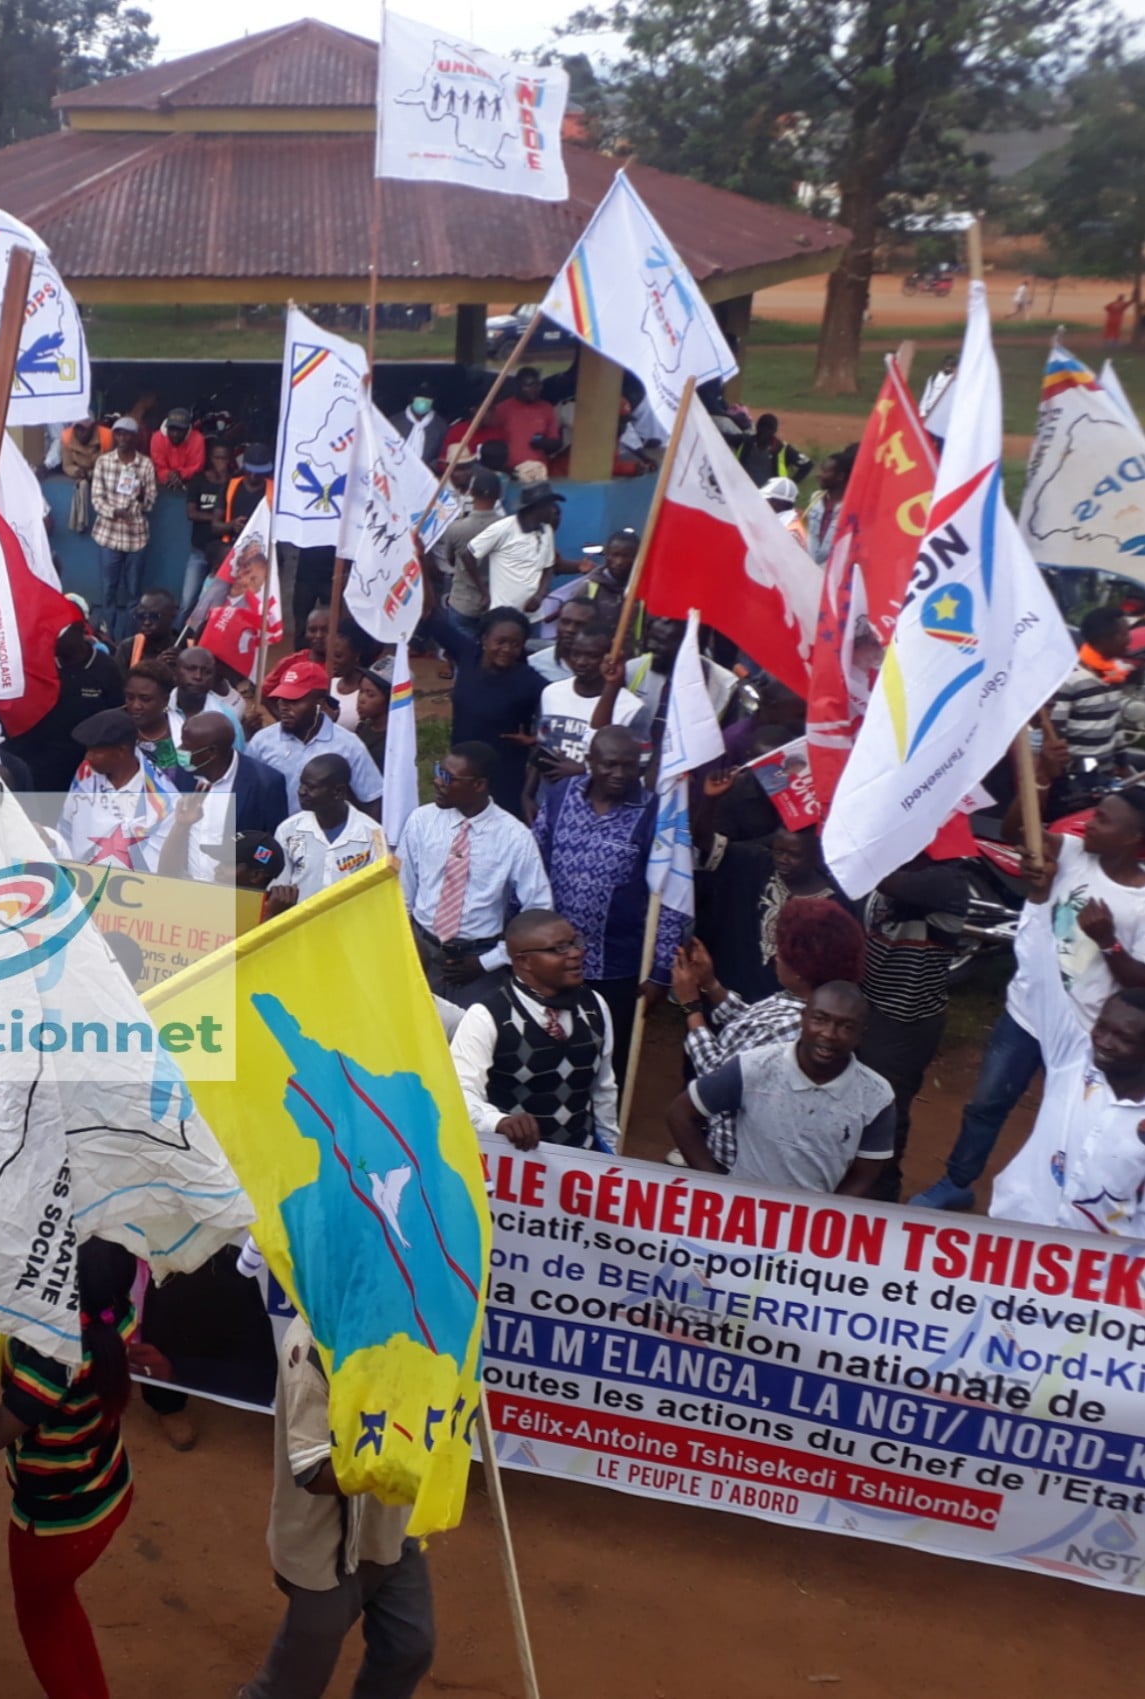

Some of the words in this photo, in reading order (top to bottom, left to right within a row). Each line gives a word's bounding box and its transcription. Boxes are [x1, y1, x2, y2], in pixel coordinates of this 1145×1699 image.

[22, 282, 57, 322] DPS
[92, 911, 183, 947] QUE/VILLE
[187, 927, 211, 953] DE
[15, 1203, 63, 1292] SOCIAL
[40, 1214, 80, 1306] RATIE
[558, 1167, 888, 1266] GÉNÉRATION
[901, 1220, 1145, 1312] TSHISEK
[489, 1248, 529, 1274] on
[542, 1253, 586, 1282] de
[598, 1262, 689, 1302] BENI
[703, 1286, 949, 1356] TERRITOIRE
[987, 1334, 1145, 1395] Nord-Ki
[530, 1287, 802, 1364] coordination
[817, 1347, 1032, 1411] nationale
[1048, 1388, 1107, 1424] de
[881, 1279, 918, 1306] et
[930, 1284, 978, 1316] de
[991, 1294, 1145, 1352] dévelop
[482, 1364, 580, 1401] outes
[593, 1380, 645, 1412] les
[657, 1398, 795, 1443] actions
[807, 1426, 857, 1458] du
[869, 1440, 967, 1480] Chef
[975, 1463, 1024, 1492] de
[501, 1404, 679, 1460] Félix-Antoine
[687, 1440, 837, 1491] Tshisekedi
[846, 1472, 999, 1526] Tshilombo
[789, 1375, 840, 1421] LA
[857, 1389, 970, 1446] NGT/
[977, 1414, 1145, 1481] NORD-K
[596, 1456, 619, 1481] LE
[627, 1463, 702, 1498] PEUPLE
[710, 1478, 800, 1517] D'ABORD
